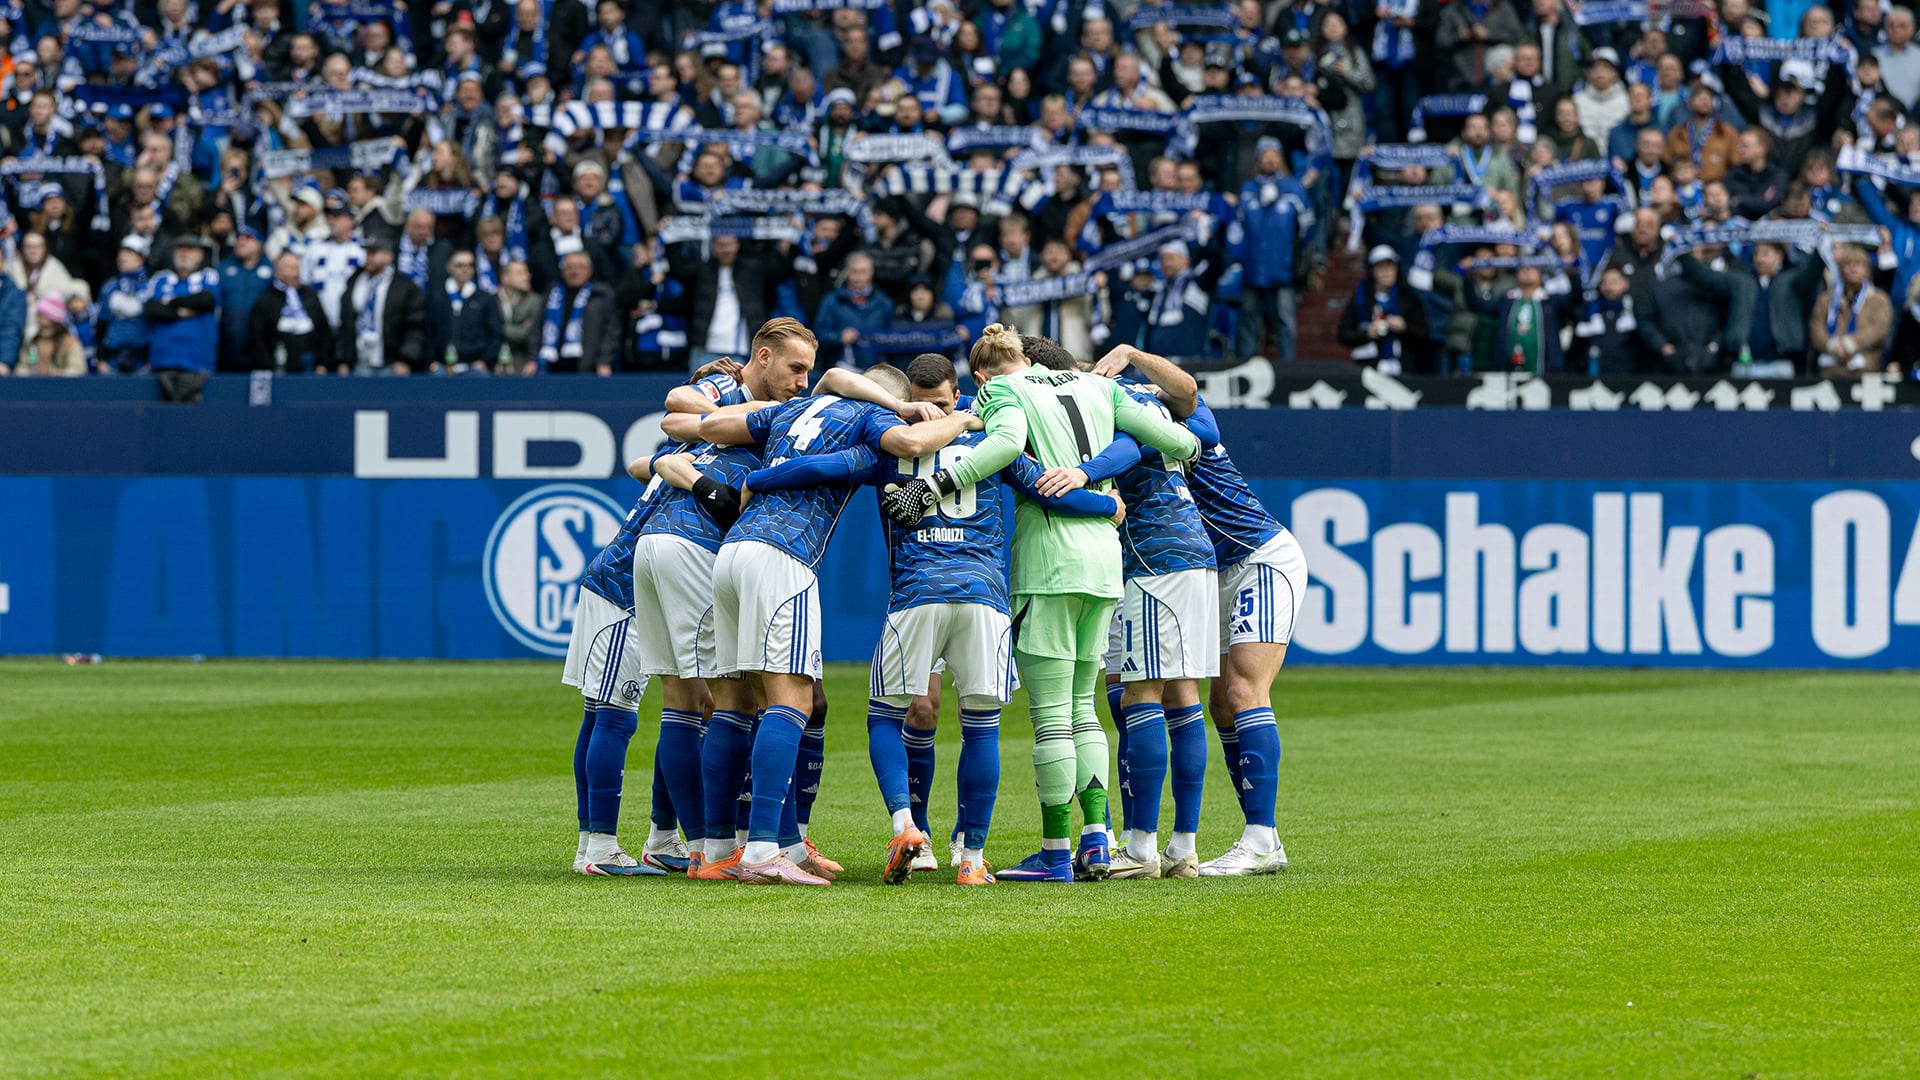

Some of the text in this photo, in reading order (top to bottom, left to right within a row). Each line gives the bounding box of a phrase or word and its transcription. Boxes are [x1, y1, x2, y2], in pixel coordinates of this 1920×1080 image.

[787, 394, 842, 451] 4
[1056, 395, 1092, 463] 1
[917, 527, 964, 542] EL-FAOUZI
[1291, 488, 1775, 657] Schalke
